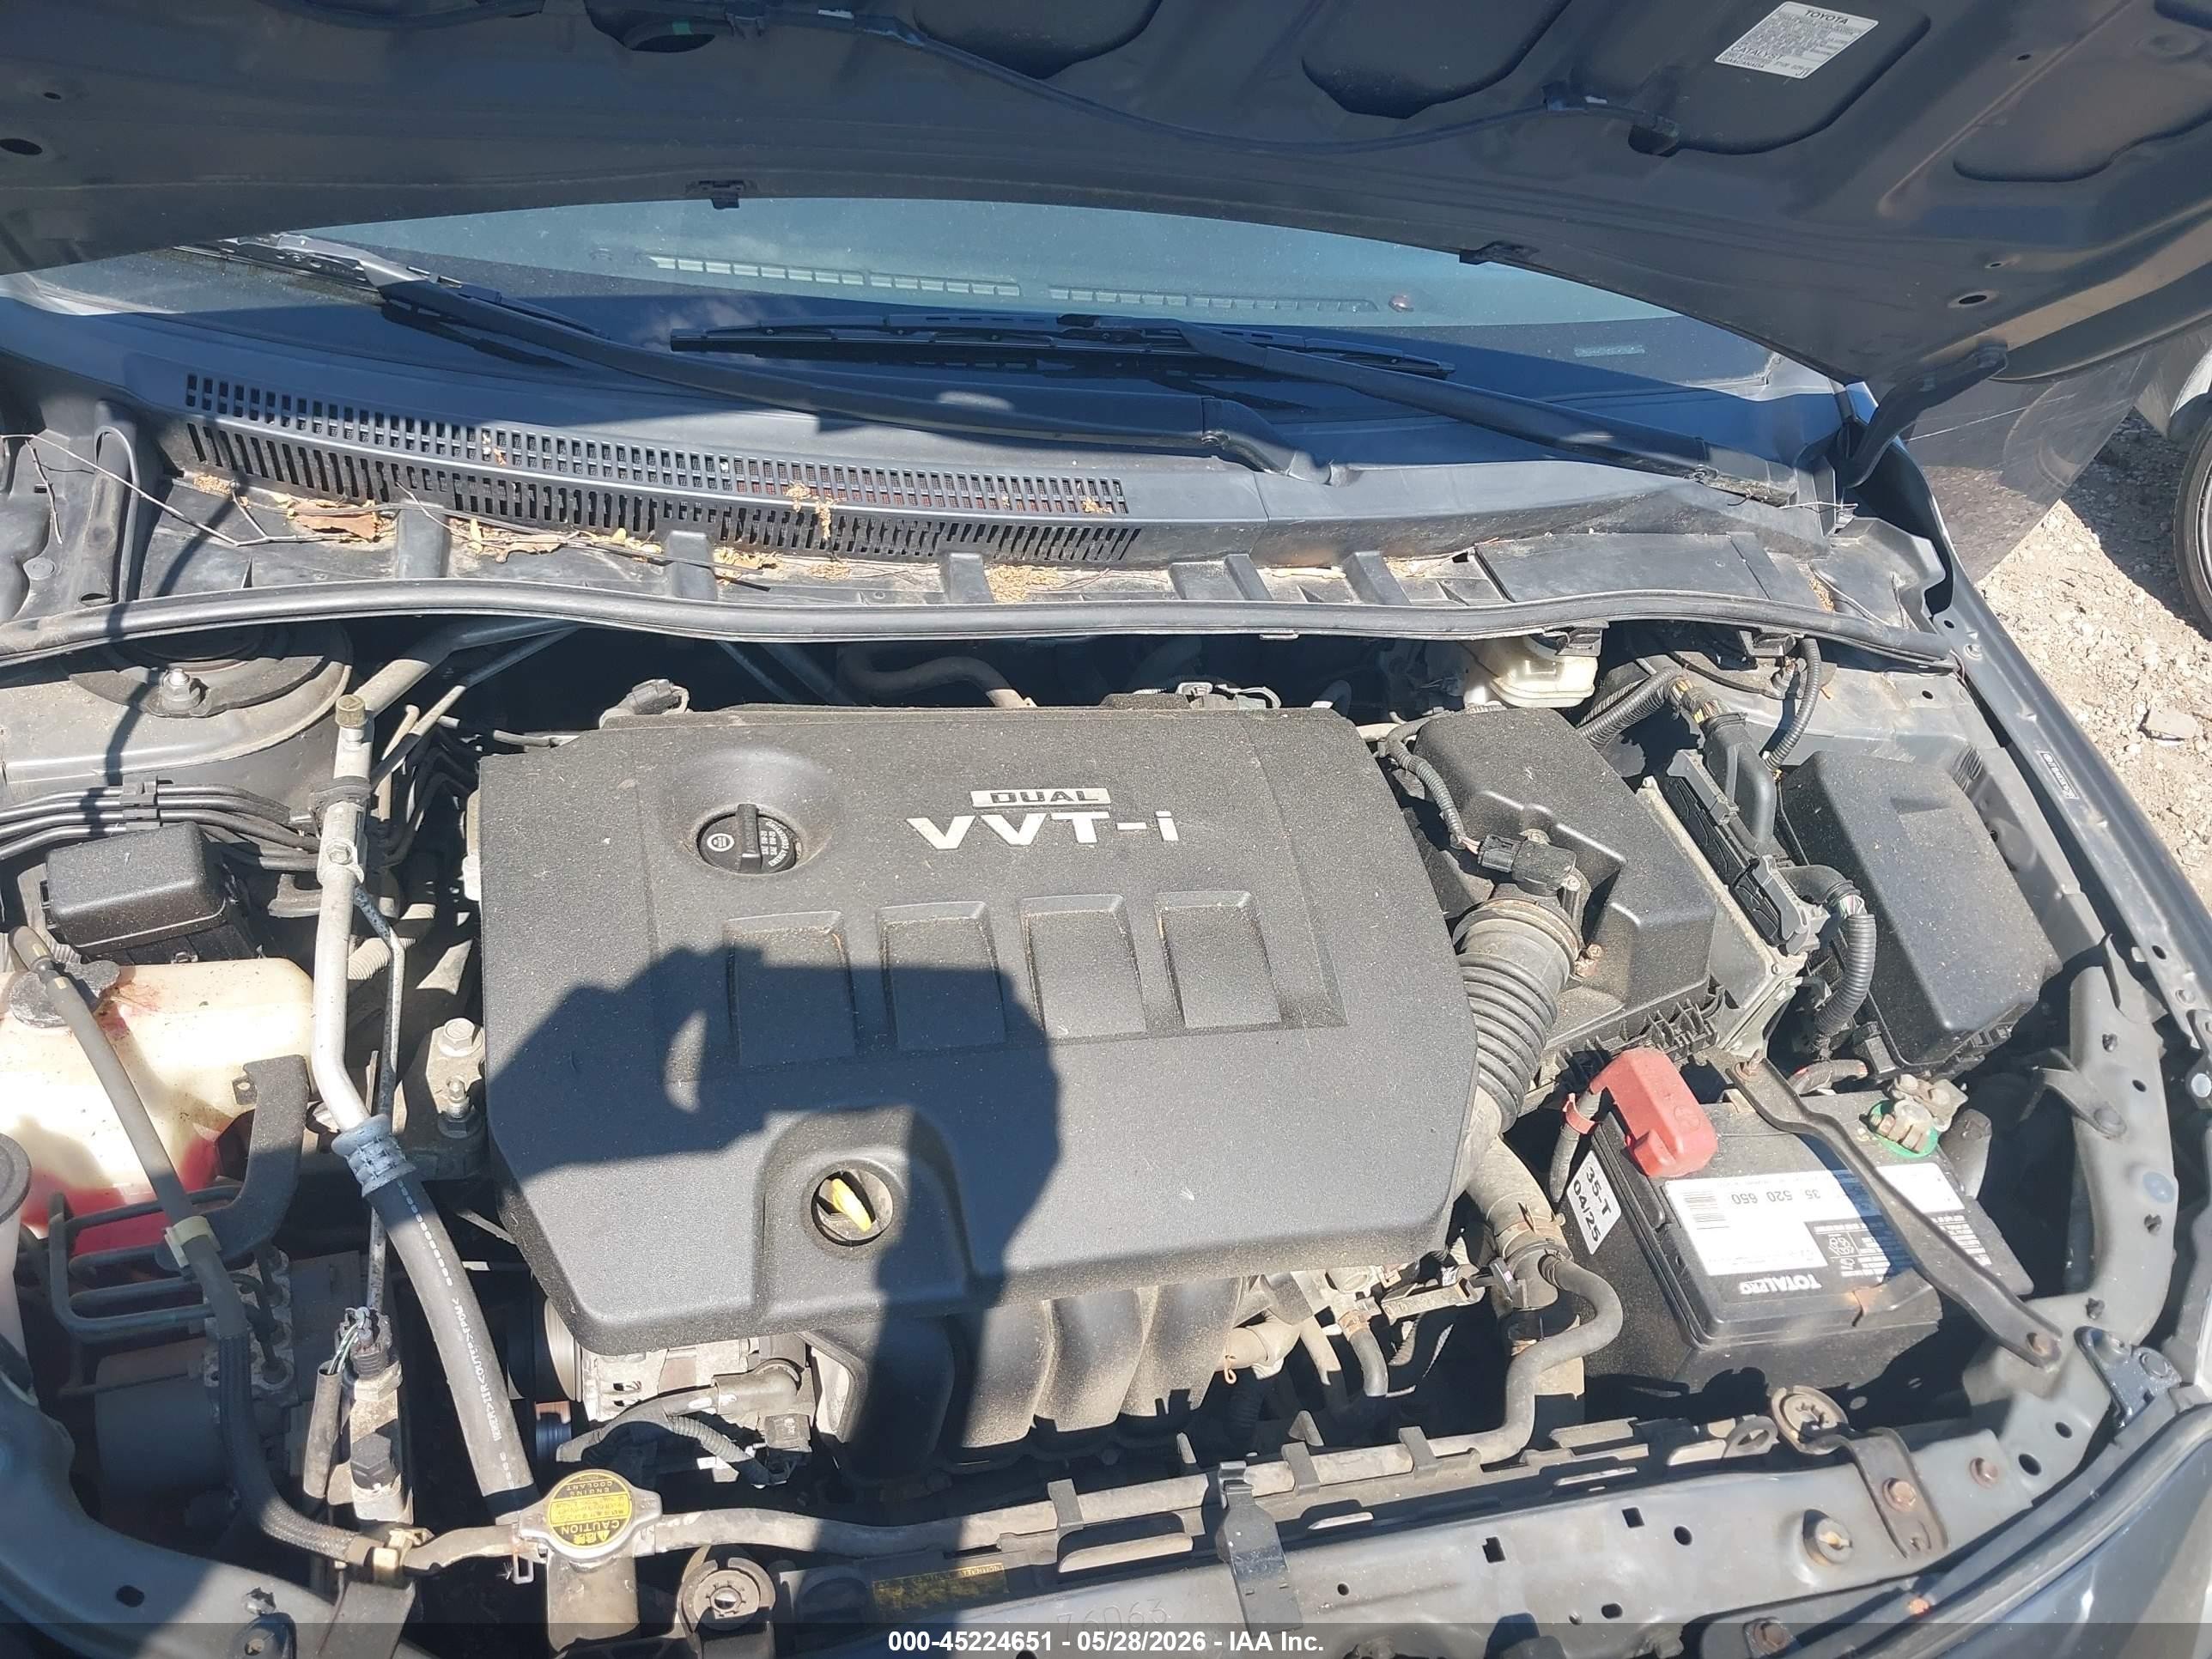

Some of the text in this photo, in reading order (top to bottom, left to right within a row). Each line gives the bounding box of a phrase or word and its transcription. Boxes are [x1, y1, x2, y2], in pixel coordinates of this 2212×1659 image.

[1804, 9, 1849, 25] TOYOTA
[1731, 46, 1784, 60] CATALYST
[989, 790, 1099, 804] DUAL
[905, 810, 1180, 850] VVT-i
[1586, 1166, 1612, 1216] 35-T
[1766, 1190, 1793, 1202] 520
[1731, 1193, 1759, 1205] 650
[1573, 1178, 1601, 1242] 04/25
[566, 1480, 613, 1492] COOLANT
[561, 1519, 621, 1535] CAUTION
